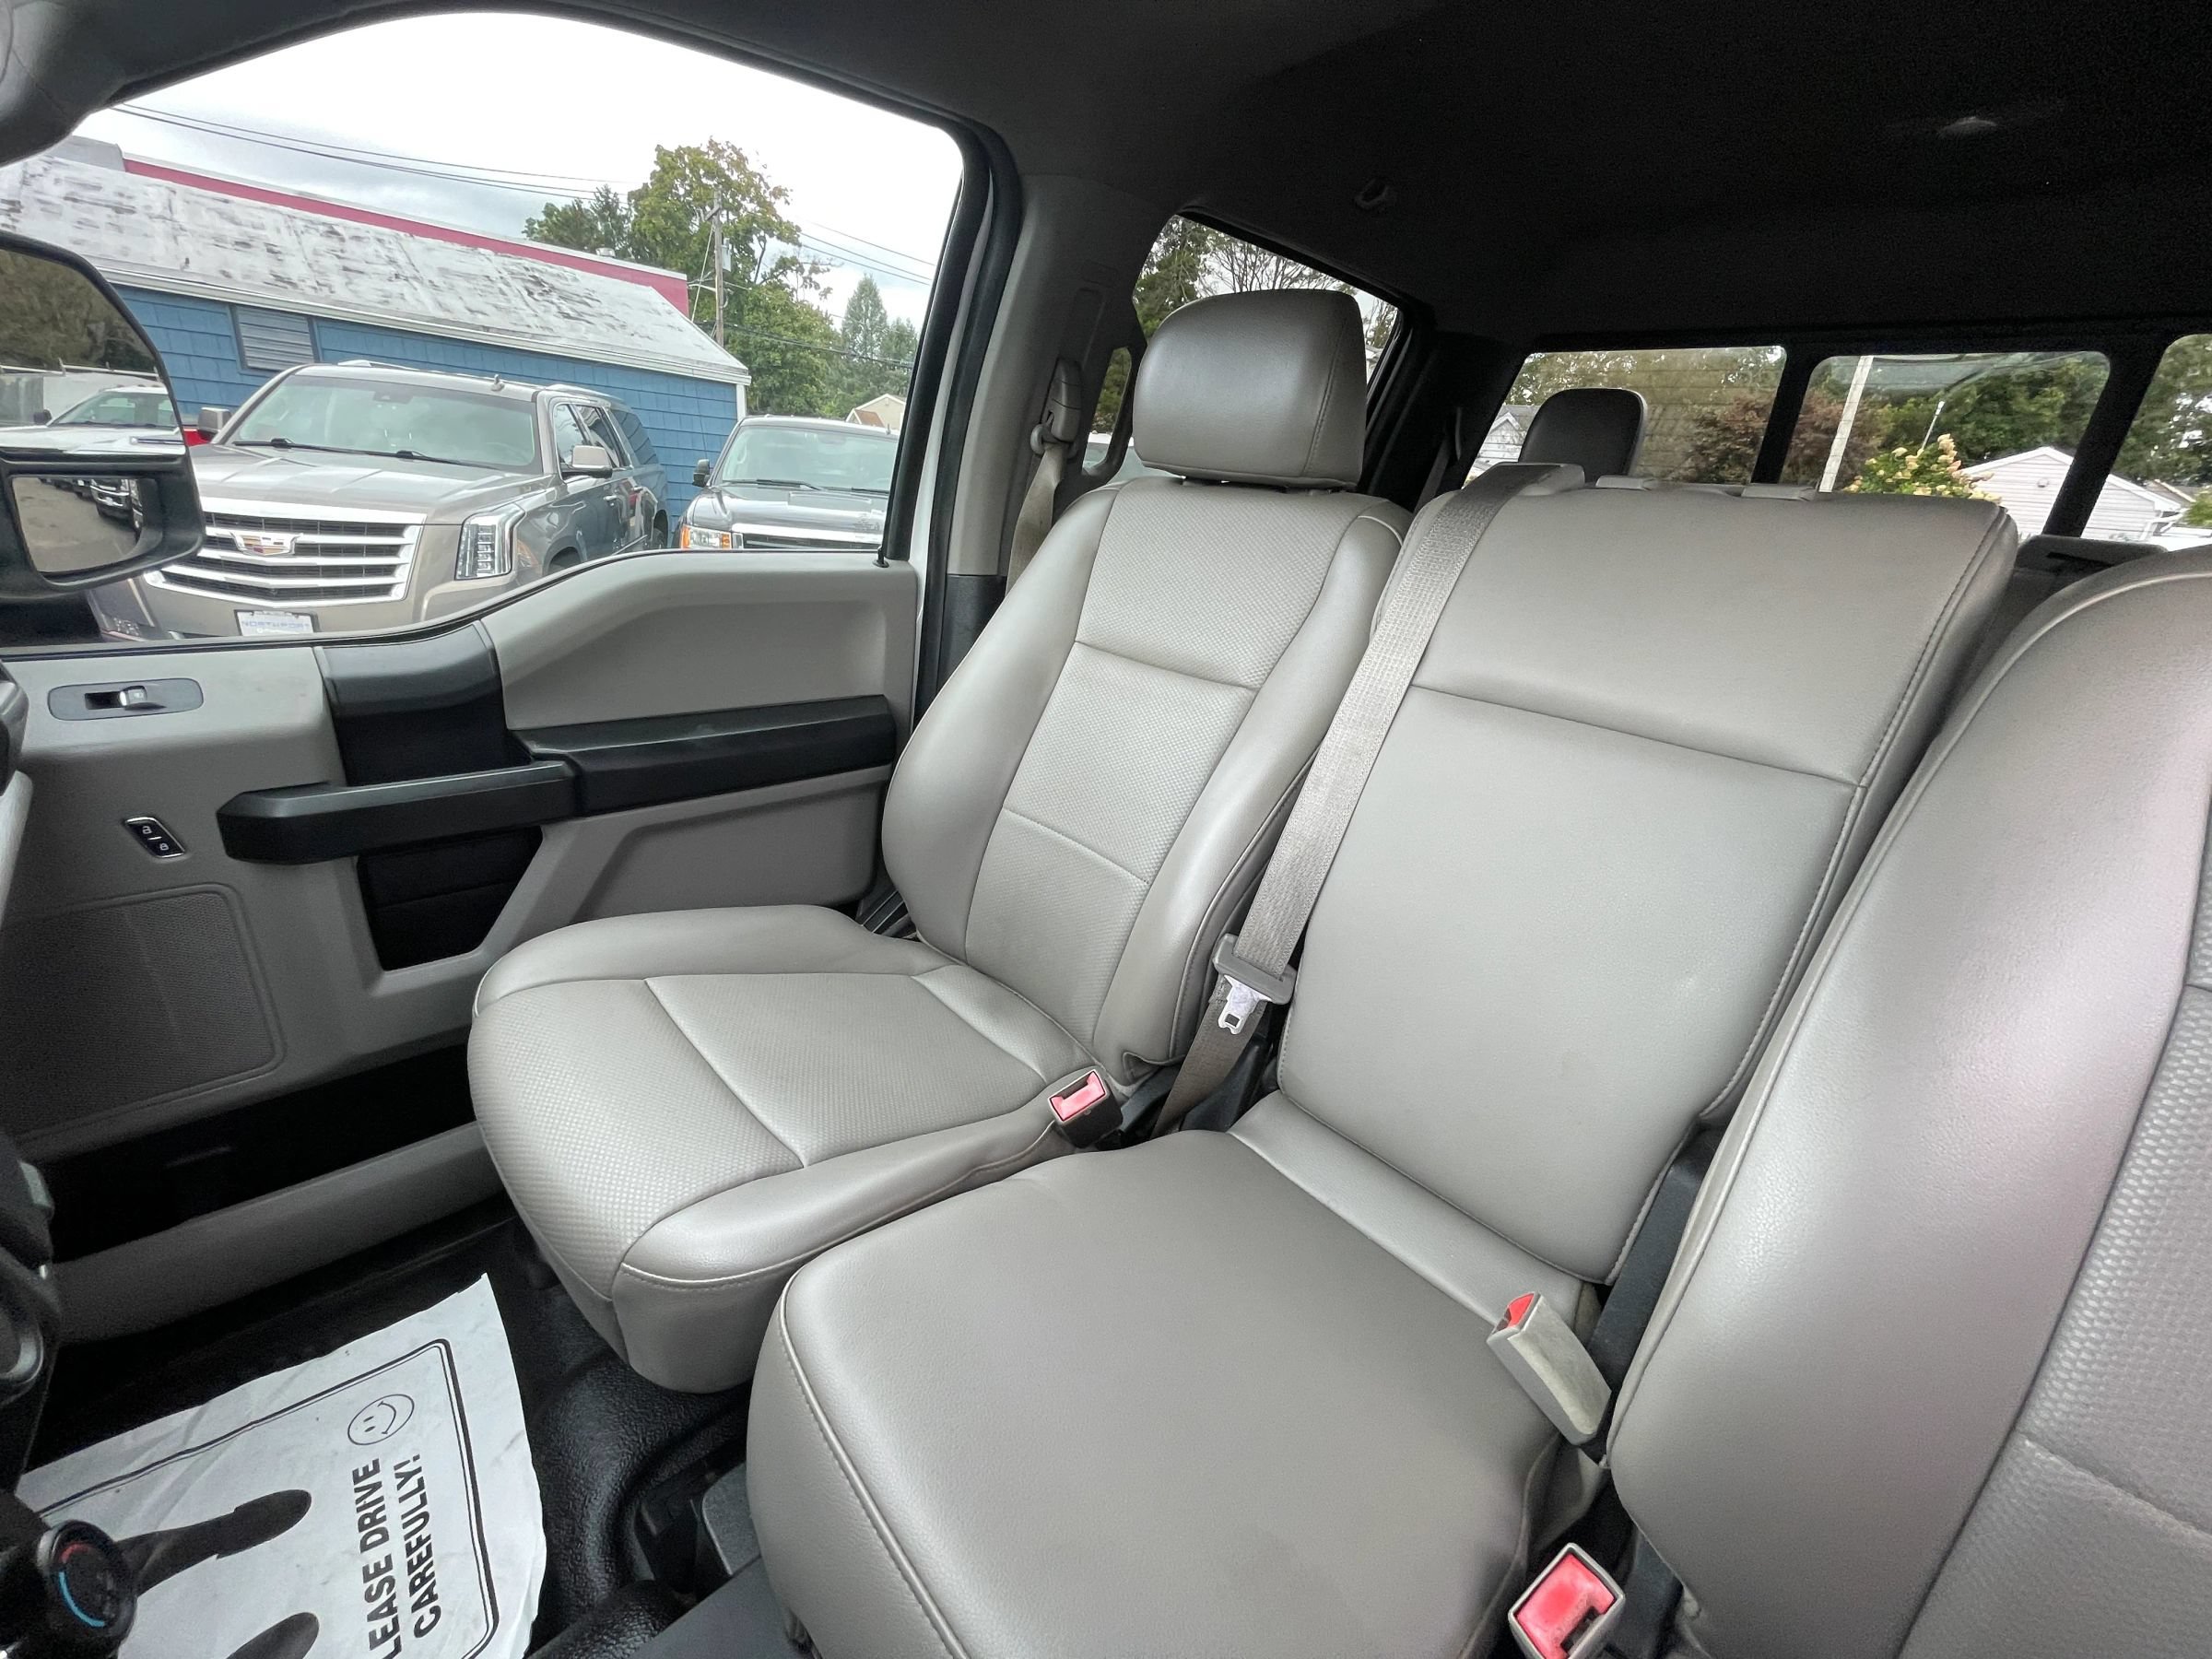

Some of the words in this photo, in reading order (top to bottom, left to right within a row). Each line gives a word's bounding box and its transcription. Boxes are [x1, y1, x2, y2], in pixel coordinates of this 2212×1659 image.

[352, 1458, 389, 1553] DRIVE
[394, 1453, 441, 1638] CAREFULLY!
[361, 1553, 402, 1659] LEASE
